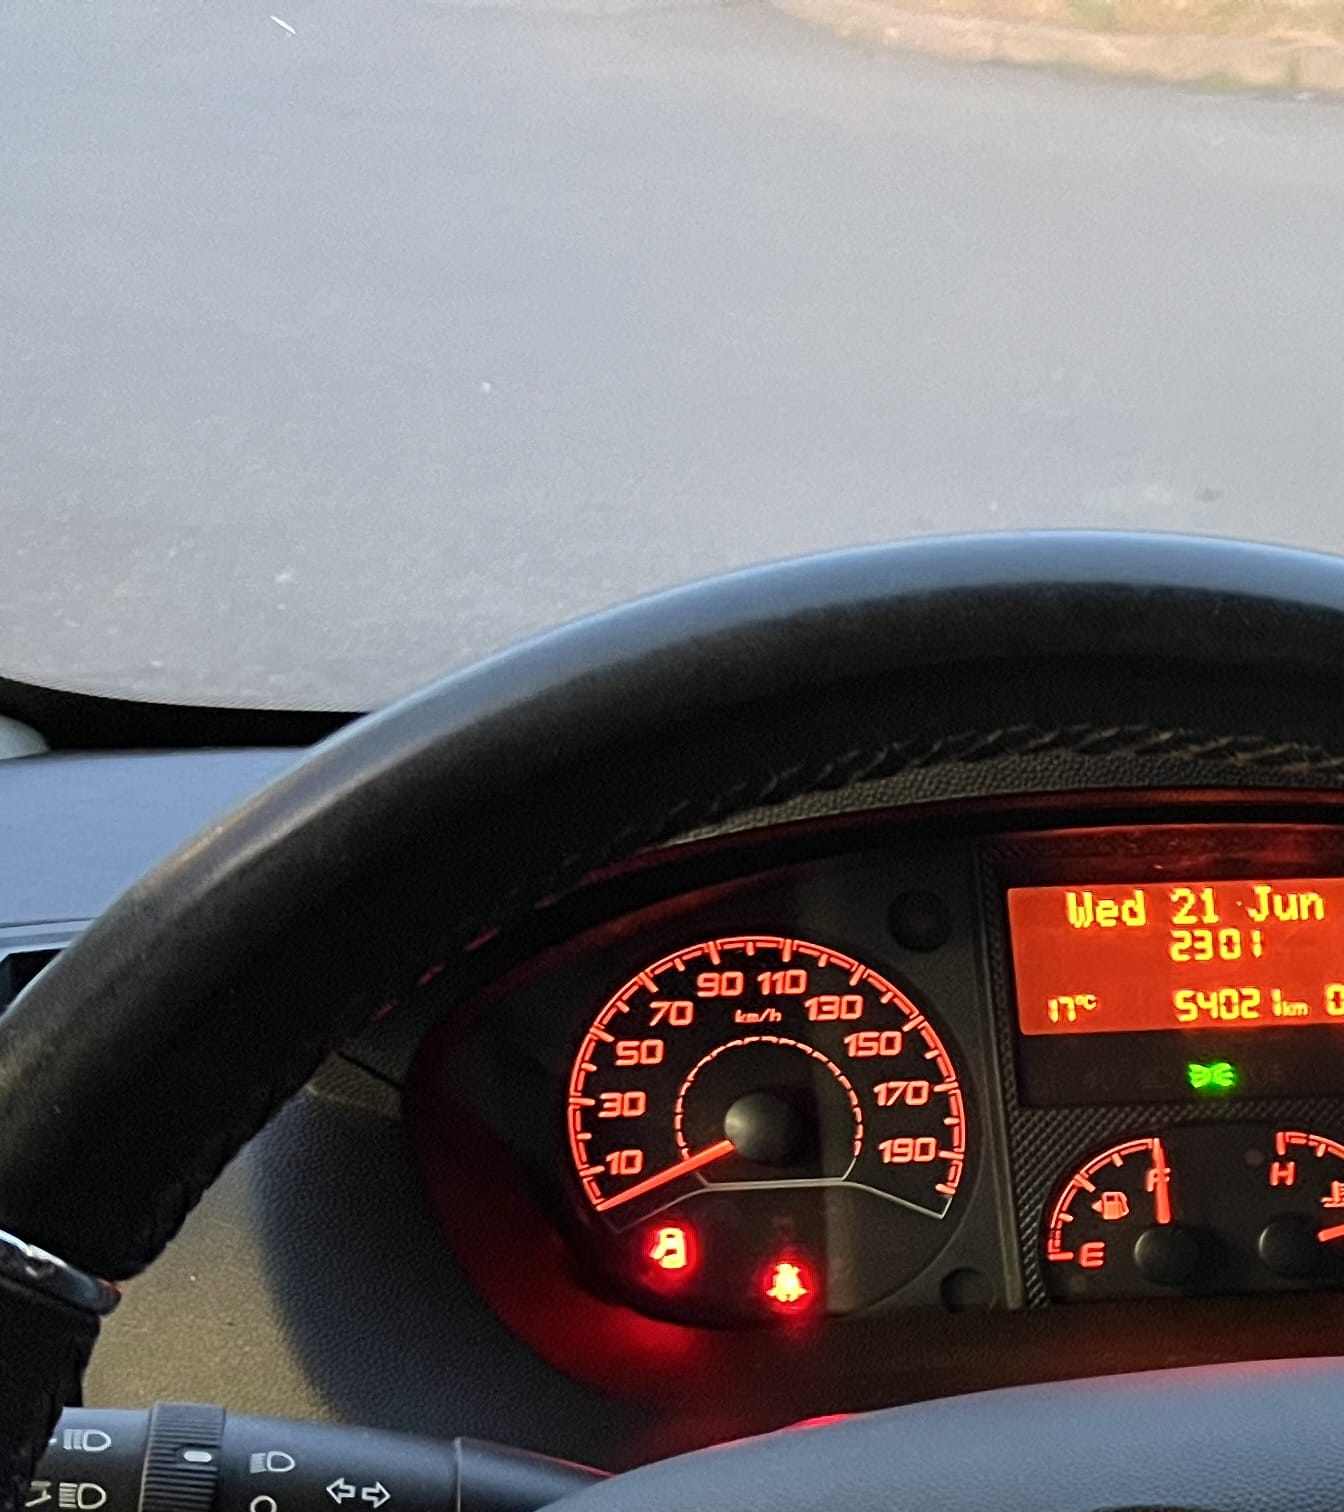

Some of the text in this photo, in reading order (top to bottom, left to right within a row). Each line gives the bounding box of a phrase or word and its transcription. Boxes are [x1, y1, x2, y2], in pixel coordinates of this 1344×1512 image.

[1066, 885, 1325, 928] Wed 21 Jun
[696, 971, 743, 997] 90
[757, 970, 807, 995] 110
[649, 1001, 693, 1026] 70
[734, 1008, 781, 1023] km/h
[804, 995, 863, 1021] 130
[615, 1039, 664, 1066] 50
[844, 1031, 902, 1057] 150
[599, 1091, 646, 1118] 30
[873, 1081, 930, 1106] 170
[606, 1149, 643, 1175] 10
[879, 1137, 937, 1163] 190
[1146, 1167, 1171, 1192] F
[1270, 1162, 1295, 1186] H
[1080, 1242, 1105, 1267] E
